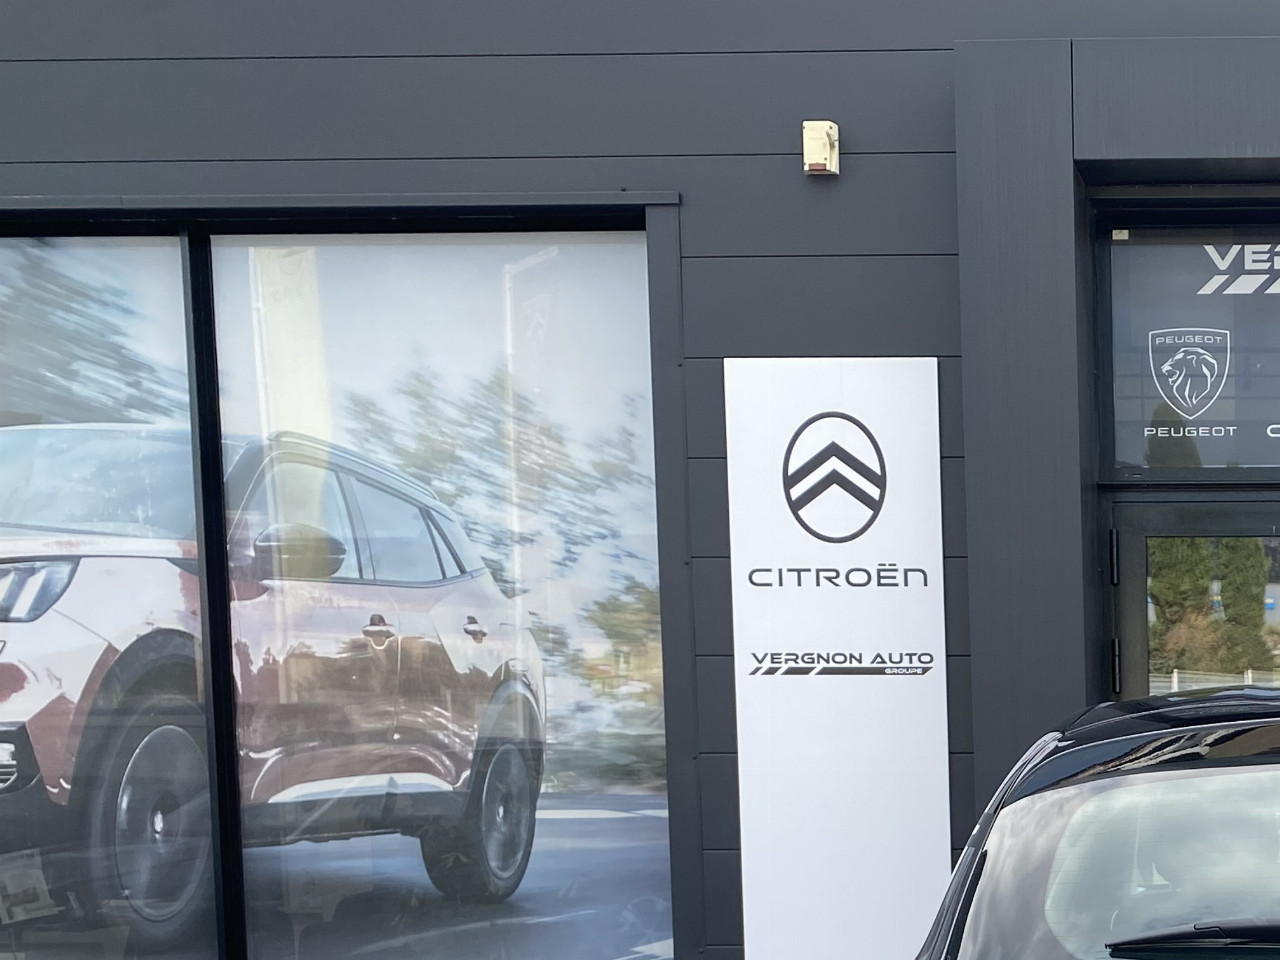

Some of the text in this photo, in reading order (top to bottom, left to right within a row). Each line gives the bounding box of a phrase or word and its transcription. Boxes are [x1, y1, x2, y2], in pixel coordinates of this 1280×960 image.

[1155, 334, 1223, 345] PEUGEOT
[1144, 426, 1237, 437] PEUGEOT
[748, 563, 928, 587] CITROËN
[751, 652, 934, 665] VERGNON AUTO
